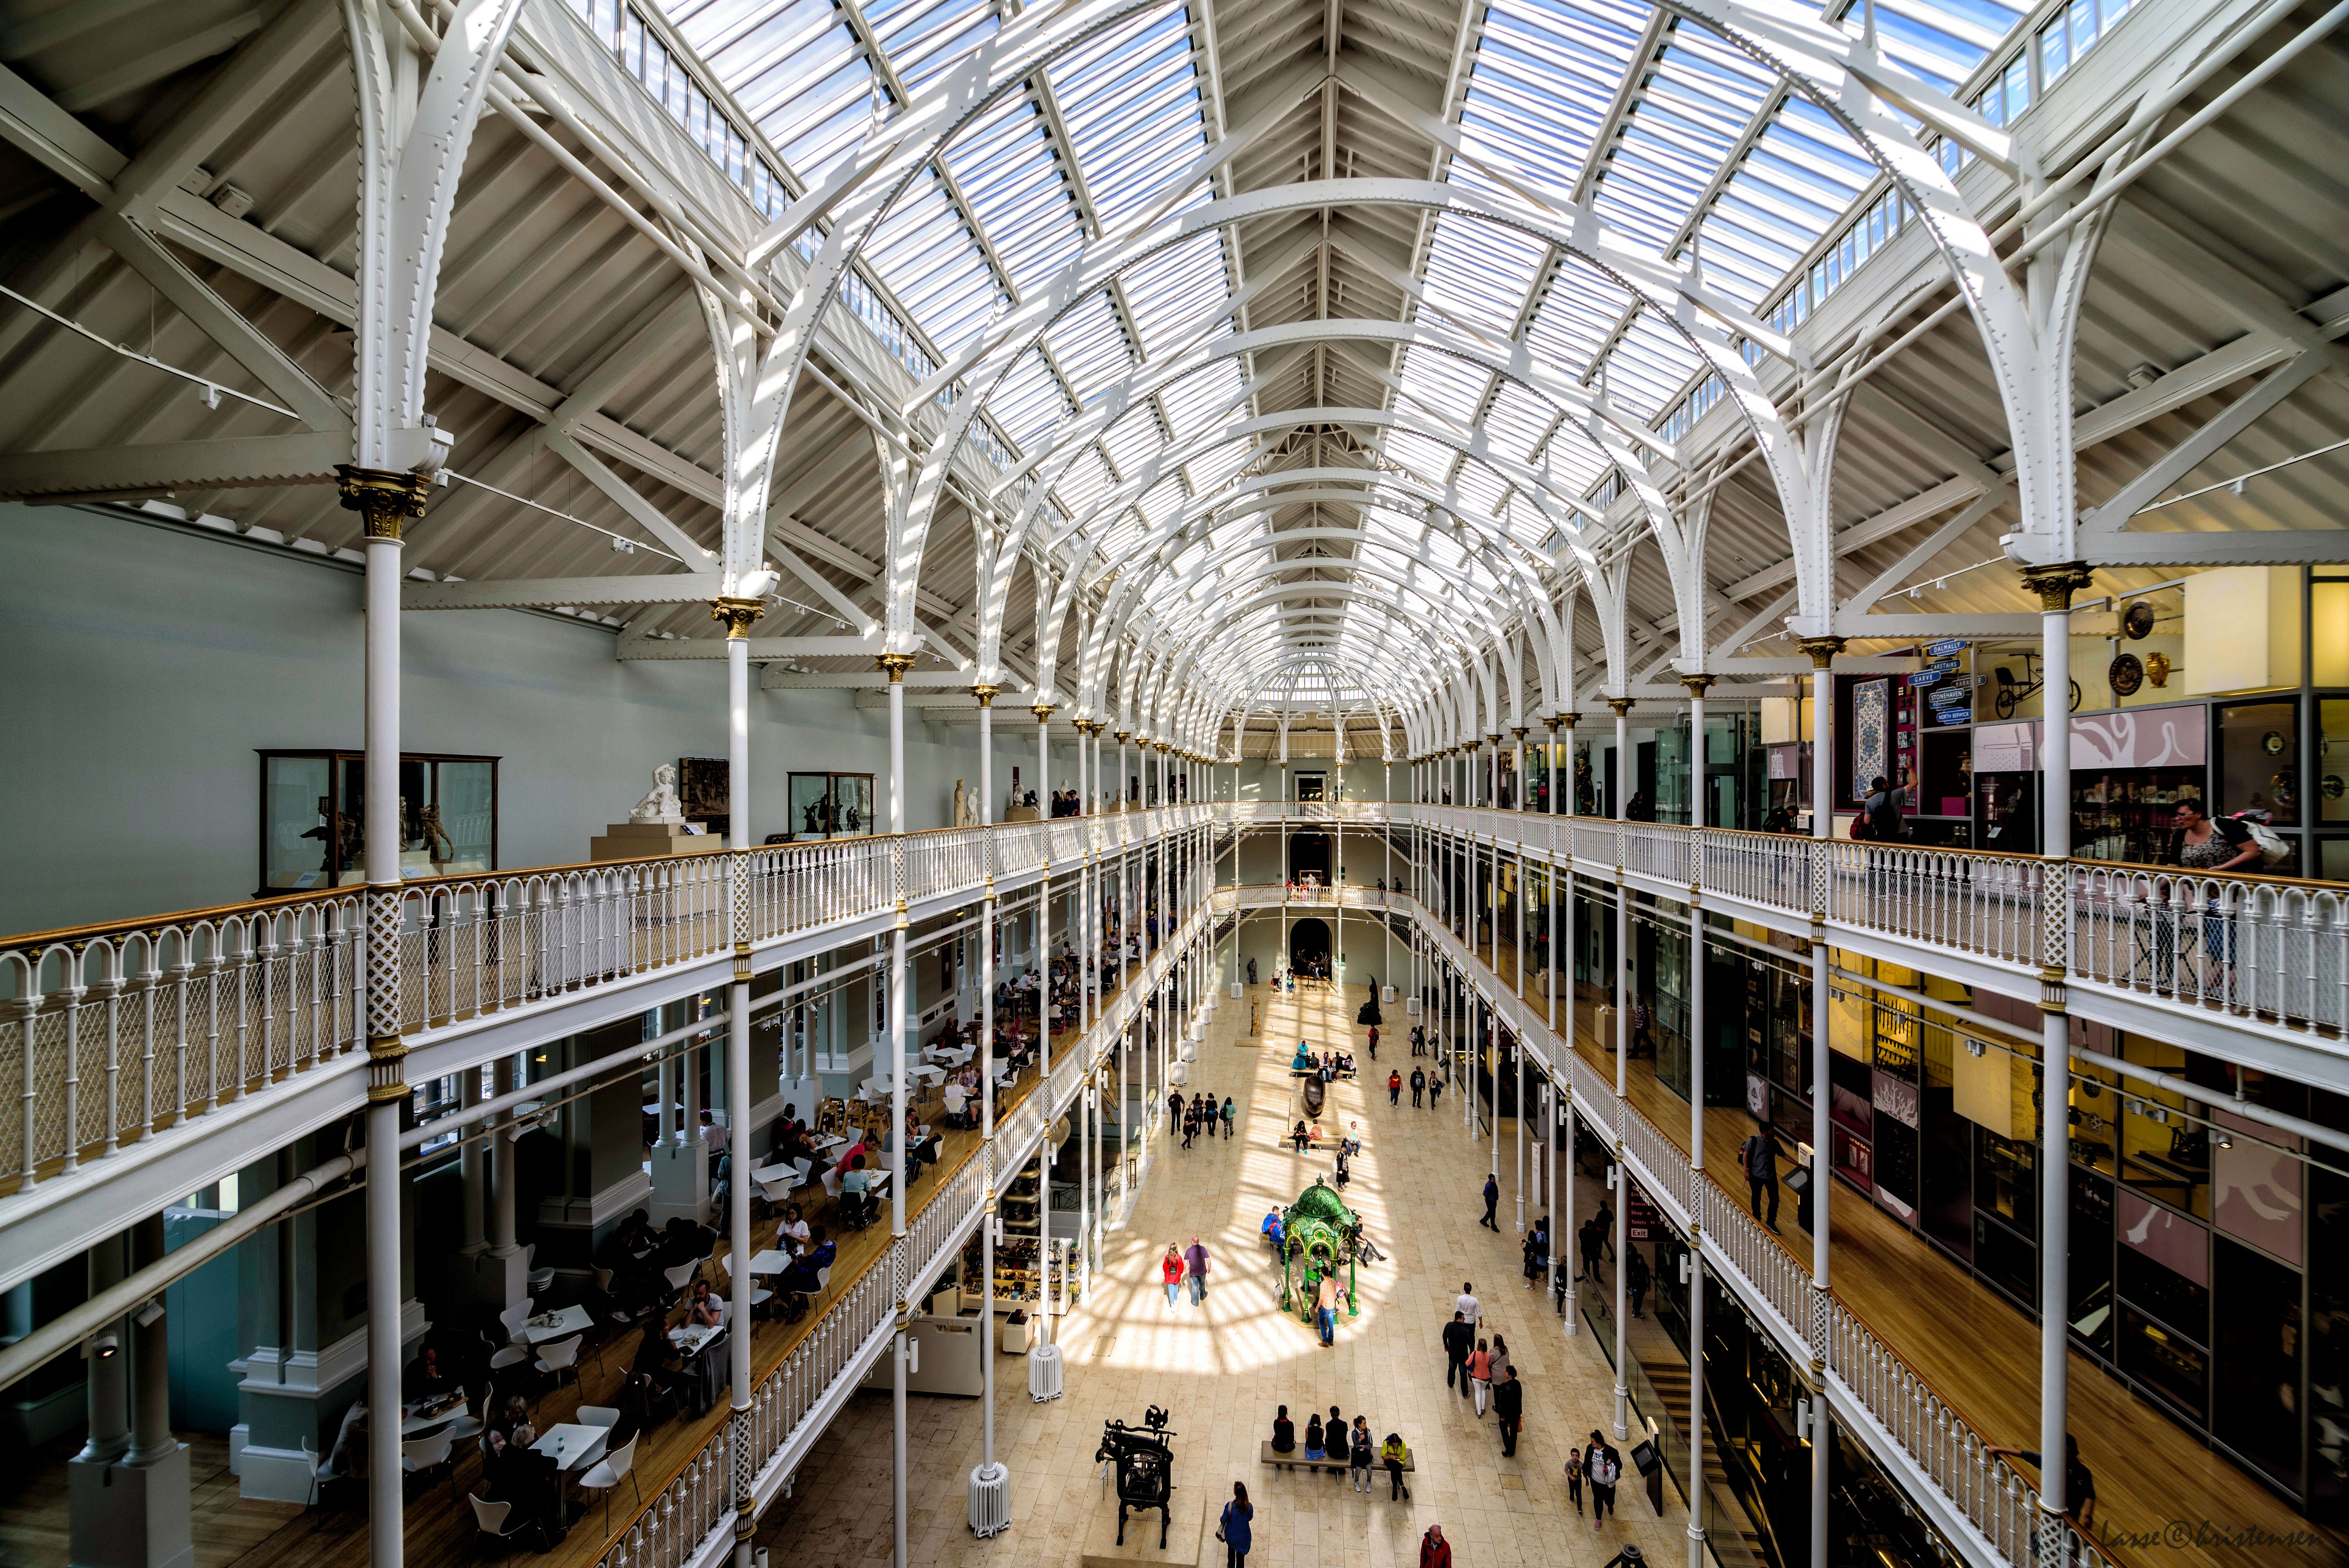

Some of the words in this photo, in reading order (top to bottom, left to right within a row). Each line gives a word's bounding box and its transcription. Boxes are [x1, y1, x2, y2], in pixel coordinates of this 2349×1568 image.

[1934, 641, 1960, 653] DALMALLY
[1930, 661, 1957, 670] CARSTAIRS
[1914, 674, 1933, 683] GARVE
[1931, 691, 1962, 700] STONEHAVEN
[1952, 710, 1969, 718] BERWICK
